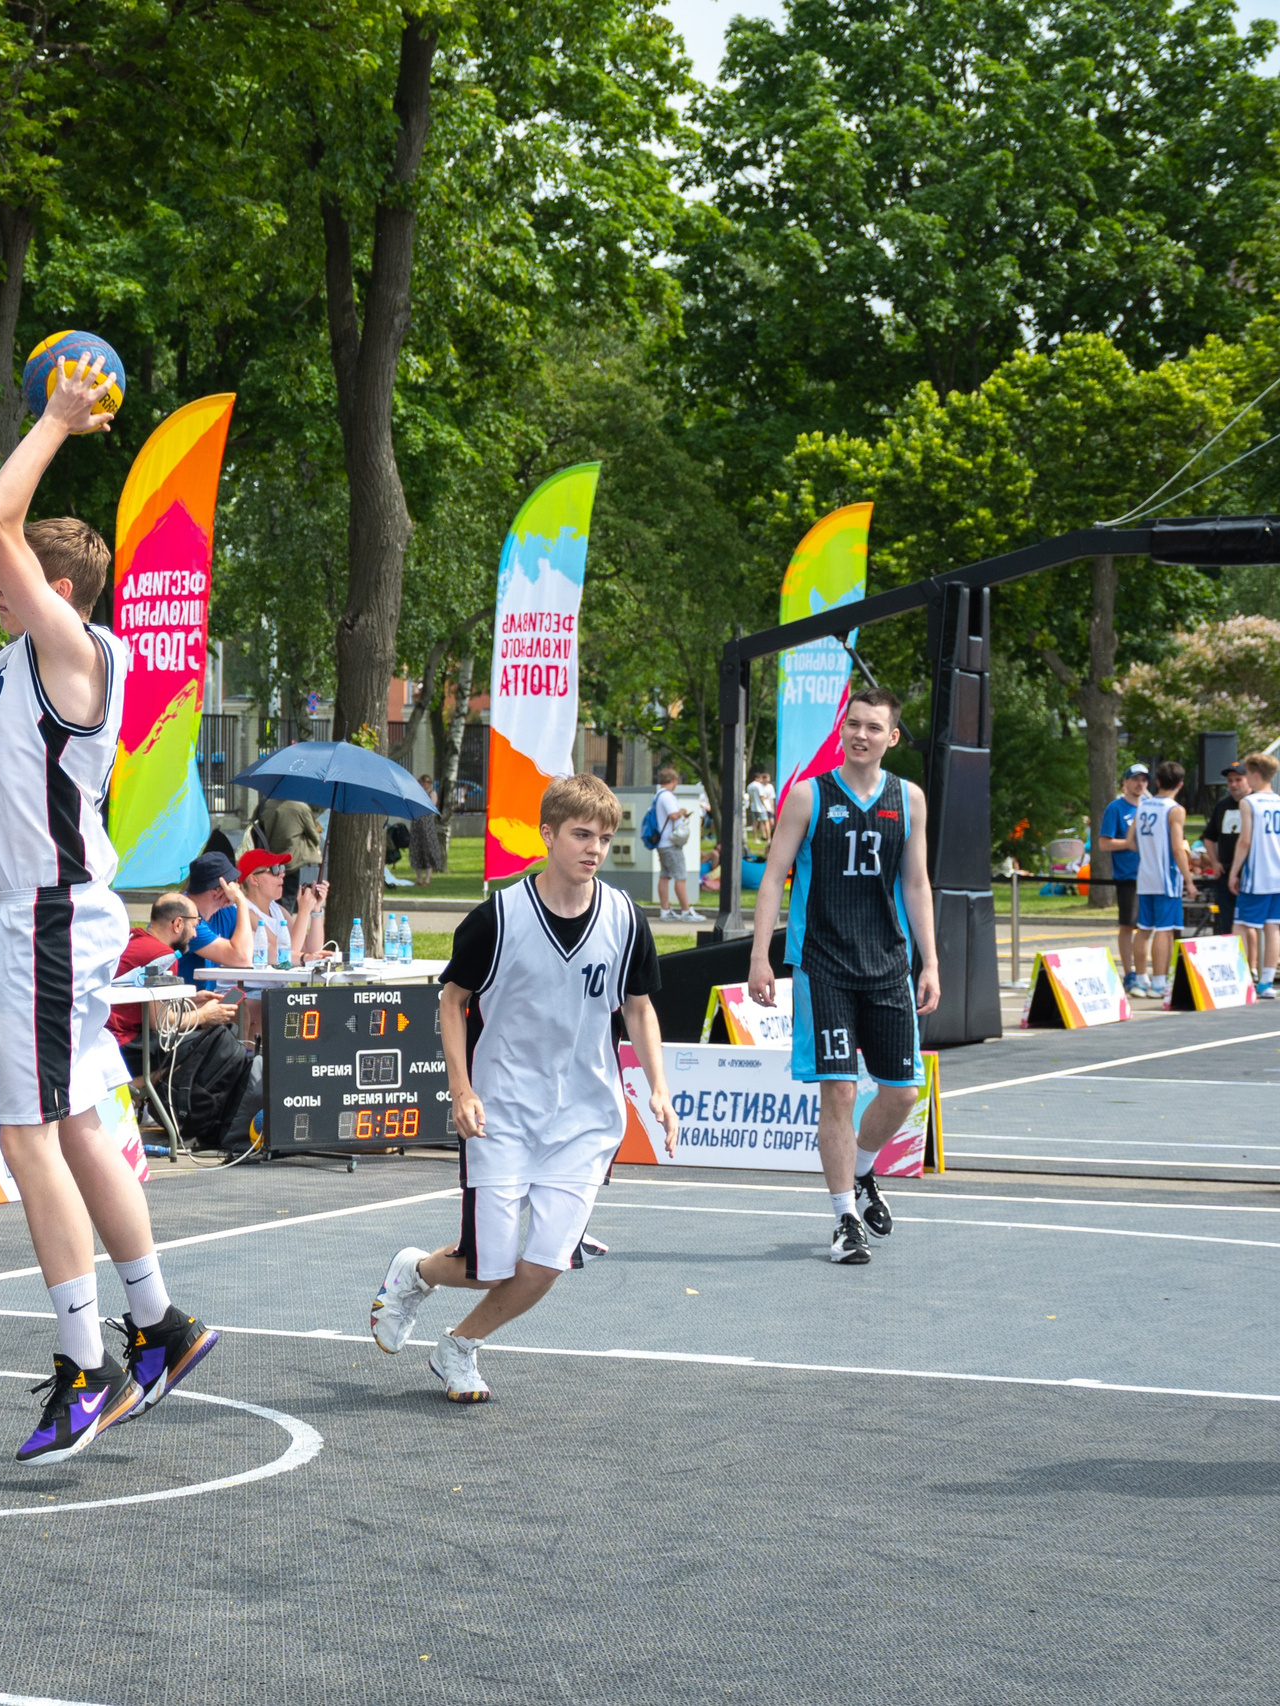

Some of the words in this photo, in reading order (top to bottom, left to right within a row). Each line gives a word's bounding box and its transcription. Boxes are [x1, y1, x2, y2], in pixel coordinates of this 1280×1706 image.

[1140, 811, 1158, 837] 22
[1264, 810, 1280, 834] 20
[843, 830, 882, 876] 13
[582, 963, 606, 1000] 10
[287, 994, 318, 1006] СЧЕТ
[354, 991, 402, 1005] ПЕРИОД
[821, 1028, 850, 1060] 13
[312, 1064, 352, 1077] ВРЕМЯ
[409, 1061, 446, 1073] АТАКИ
[283, 1096, 321, 1107] ФОЛЫ
[343, 1093, 383, 1105] ВРЕМЯ
[385, 1091, 418, 1104] ИГРЫ
[672, 1090, 820, 1126] ФЕСТИВАЛЬ
[355, 1108, 420, 1139] 6:58
[763, 1128, 819, 1151] СПОРТА
